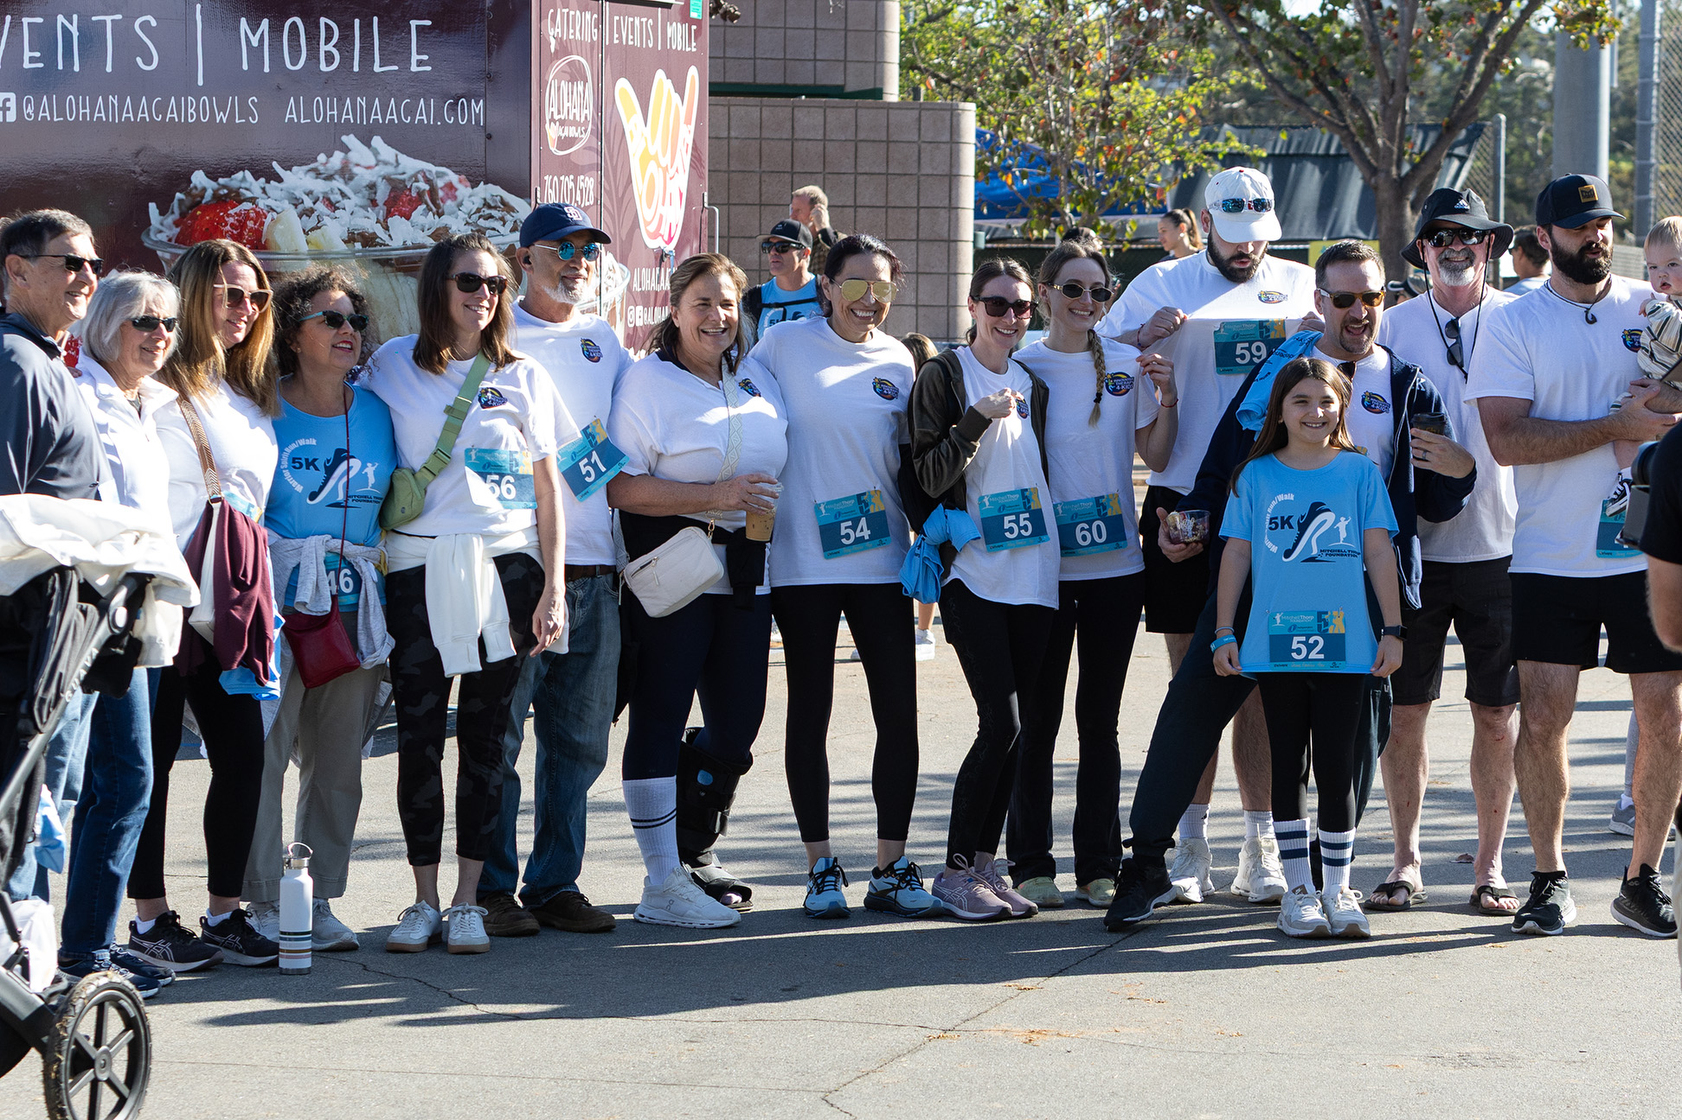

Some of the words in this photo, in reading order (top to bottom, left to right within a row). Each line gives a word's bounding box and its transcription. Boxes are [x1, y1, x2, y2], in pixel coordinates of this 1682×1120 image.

[547, 8, 598, 42] CATERING
[613, 15, 654, 48] EVENTS
[667, 22, 697, 52] MOBILE
[240, 16, 433, 73] MOBILE
[285, 96, 484, 126] ALOHANAACAI.COM
[549, 79, 590, 122] ALOHANA
[1235, 341, 1267, 365] 59
[291, 457, 321, 472] 5K
[578, 450, 607, 483] 51
[486, 474, 517, 500] 56
[840, 516, 871, 545] 54
[1003, 512, 1033, 539] 55
[1075, 520, 1107, 546] 60
[1268, 515, 1294, 531] 5K
[327, 568, 354, 595] 46
[1291, 635, 1325, 660] 52
